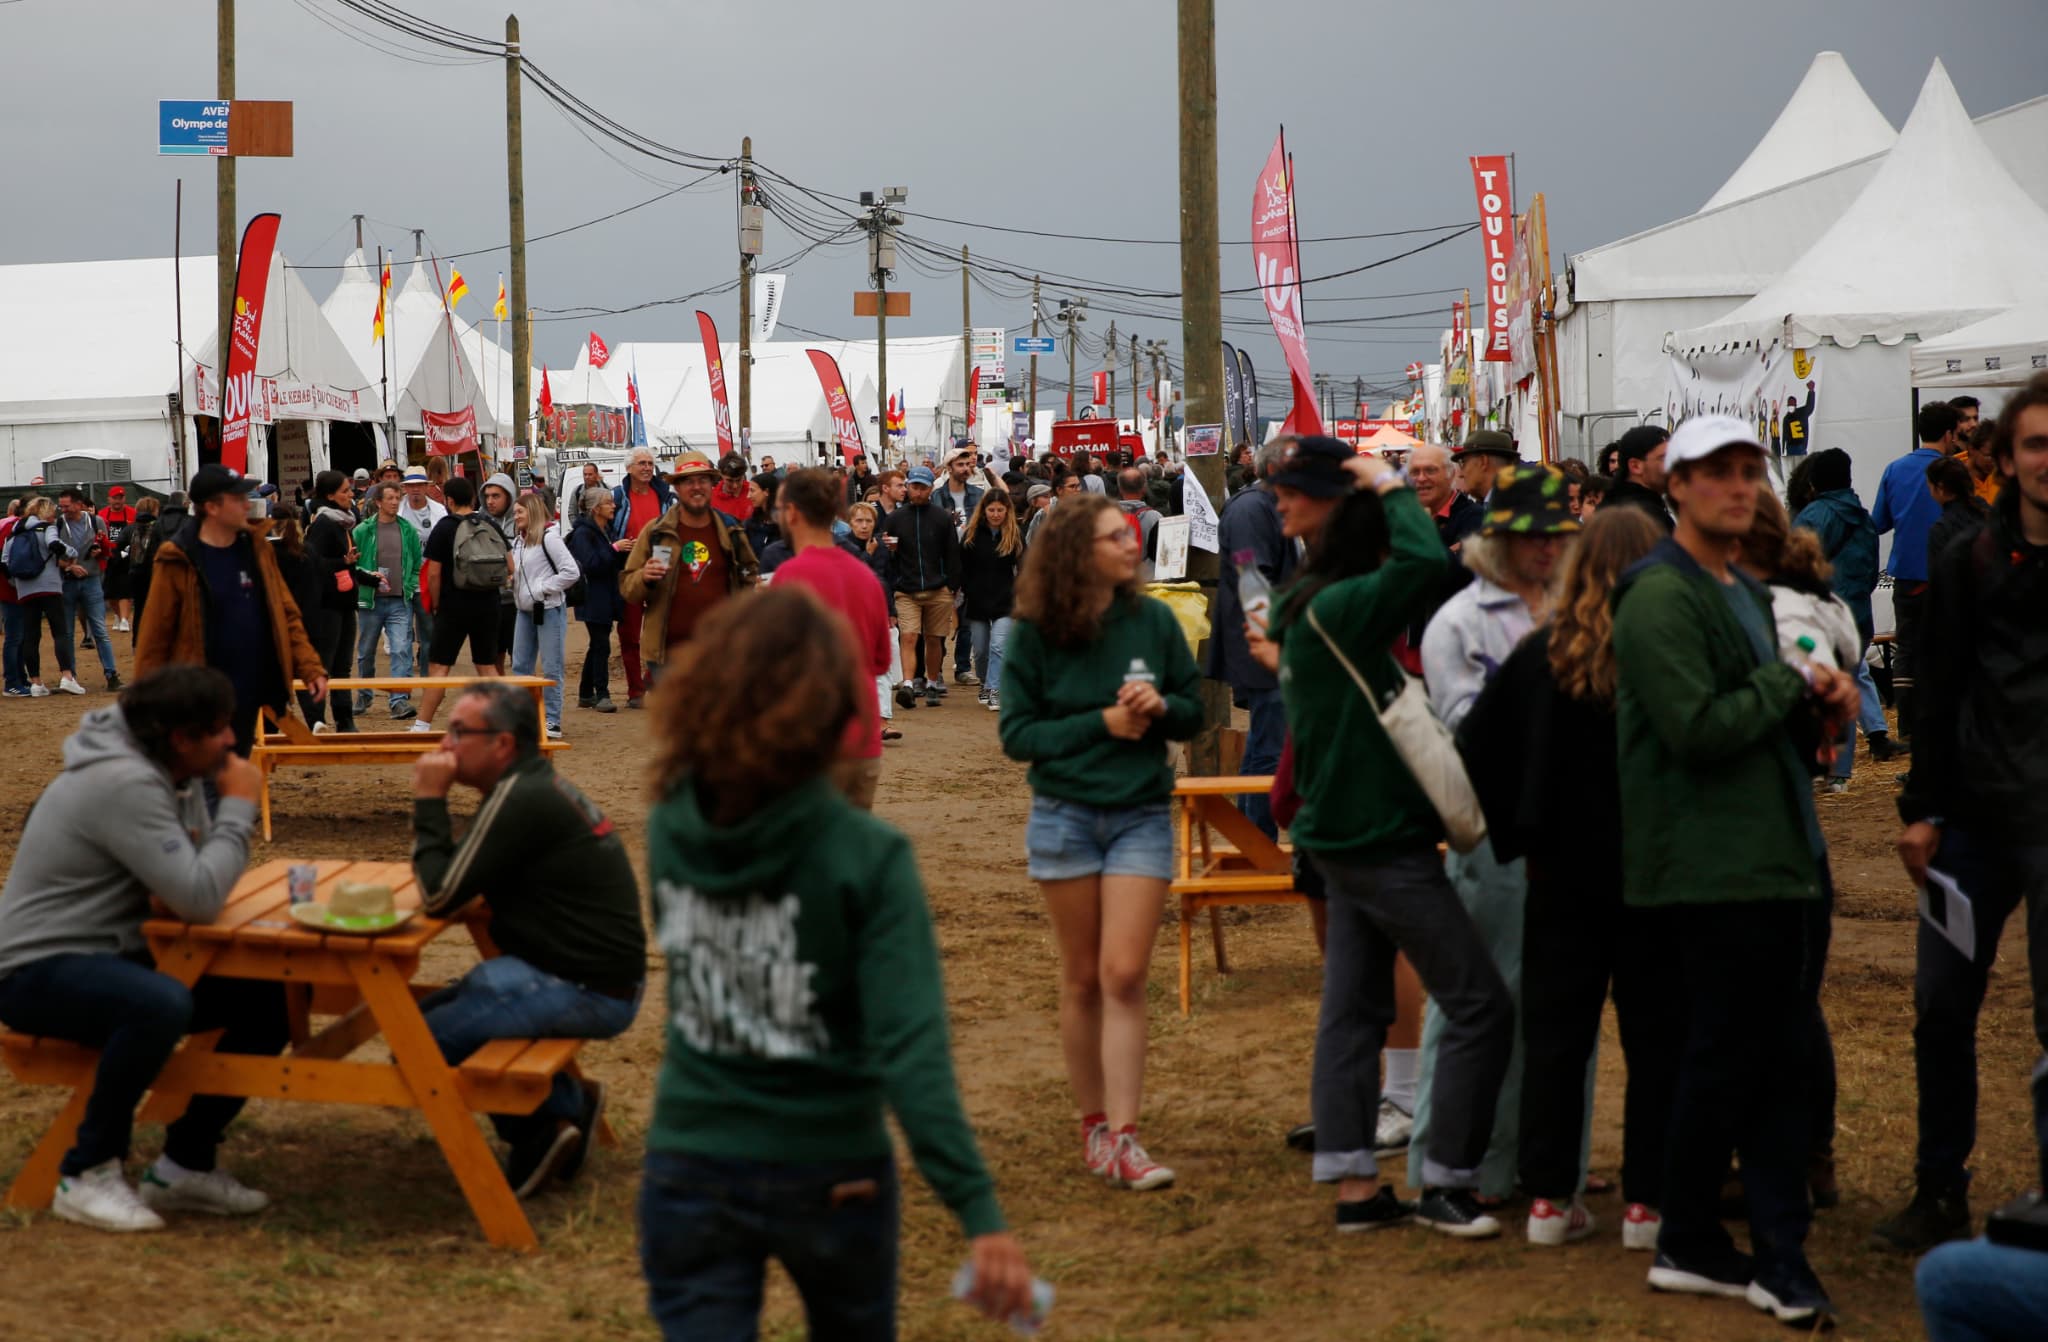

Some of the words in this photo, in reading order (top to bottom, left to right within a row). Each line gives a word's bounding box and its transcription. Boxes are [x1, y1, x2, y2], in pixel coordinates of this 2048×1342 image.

[171, 118, 213, 130] Olympe
[214, 119, 228, 129] de
[1479, 171, 1509, 350] TOULOUSE
[225, 370, 253, 422] OUI
[279, 391, 288, 406] LE
[288, 389, 311, 405] KEBAB
[317, 389, 326, 404] DU
[326, 392, 351, 413] QUERCY
[546, 410, 577, 442] PCF
[587, 408, 628, 443] GARD
[1790, 420, 1804, 439] E
[1069, 442, 1110, 454] LOXAM
